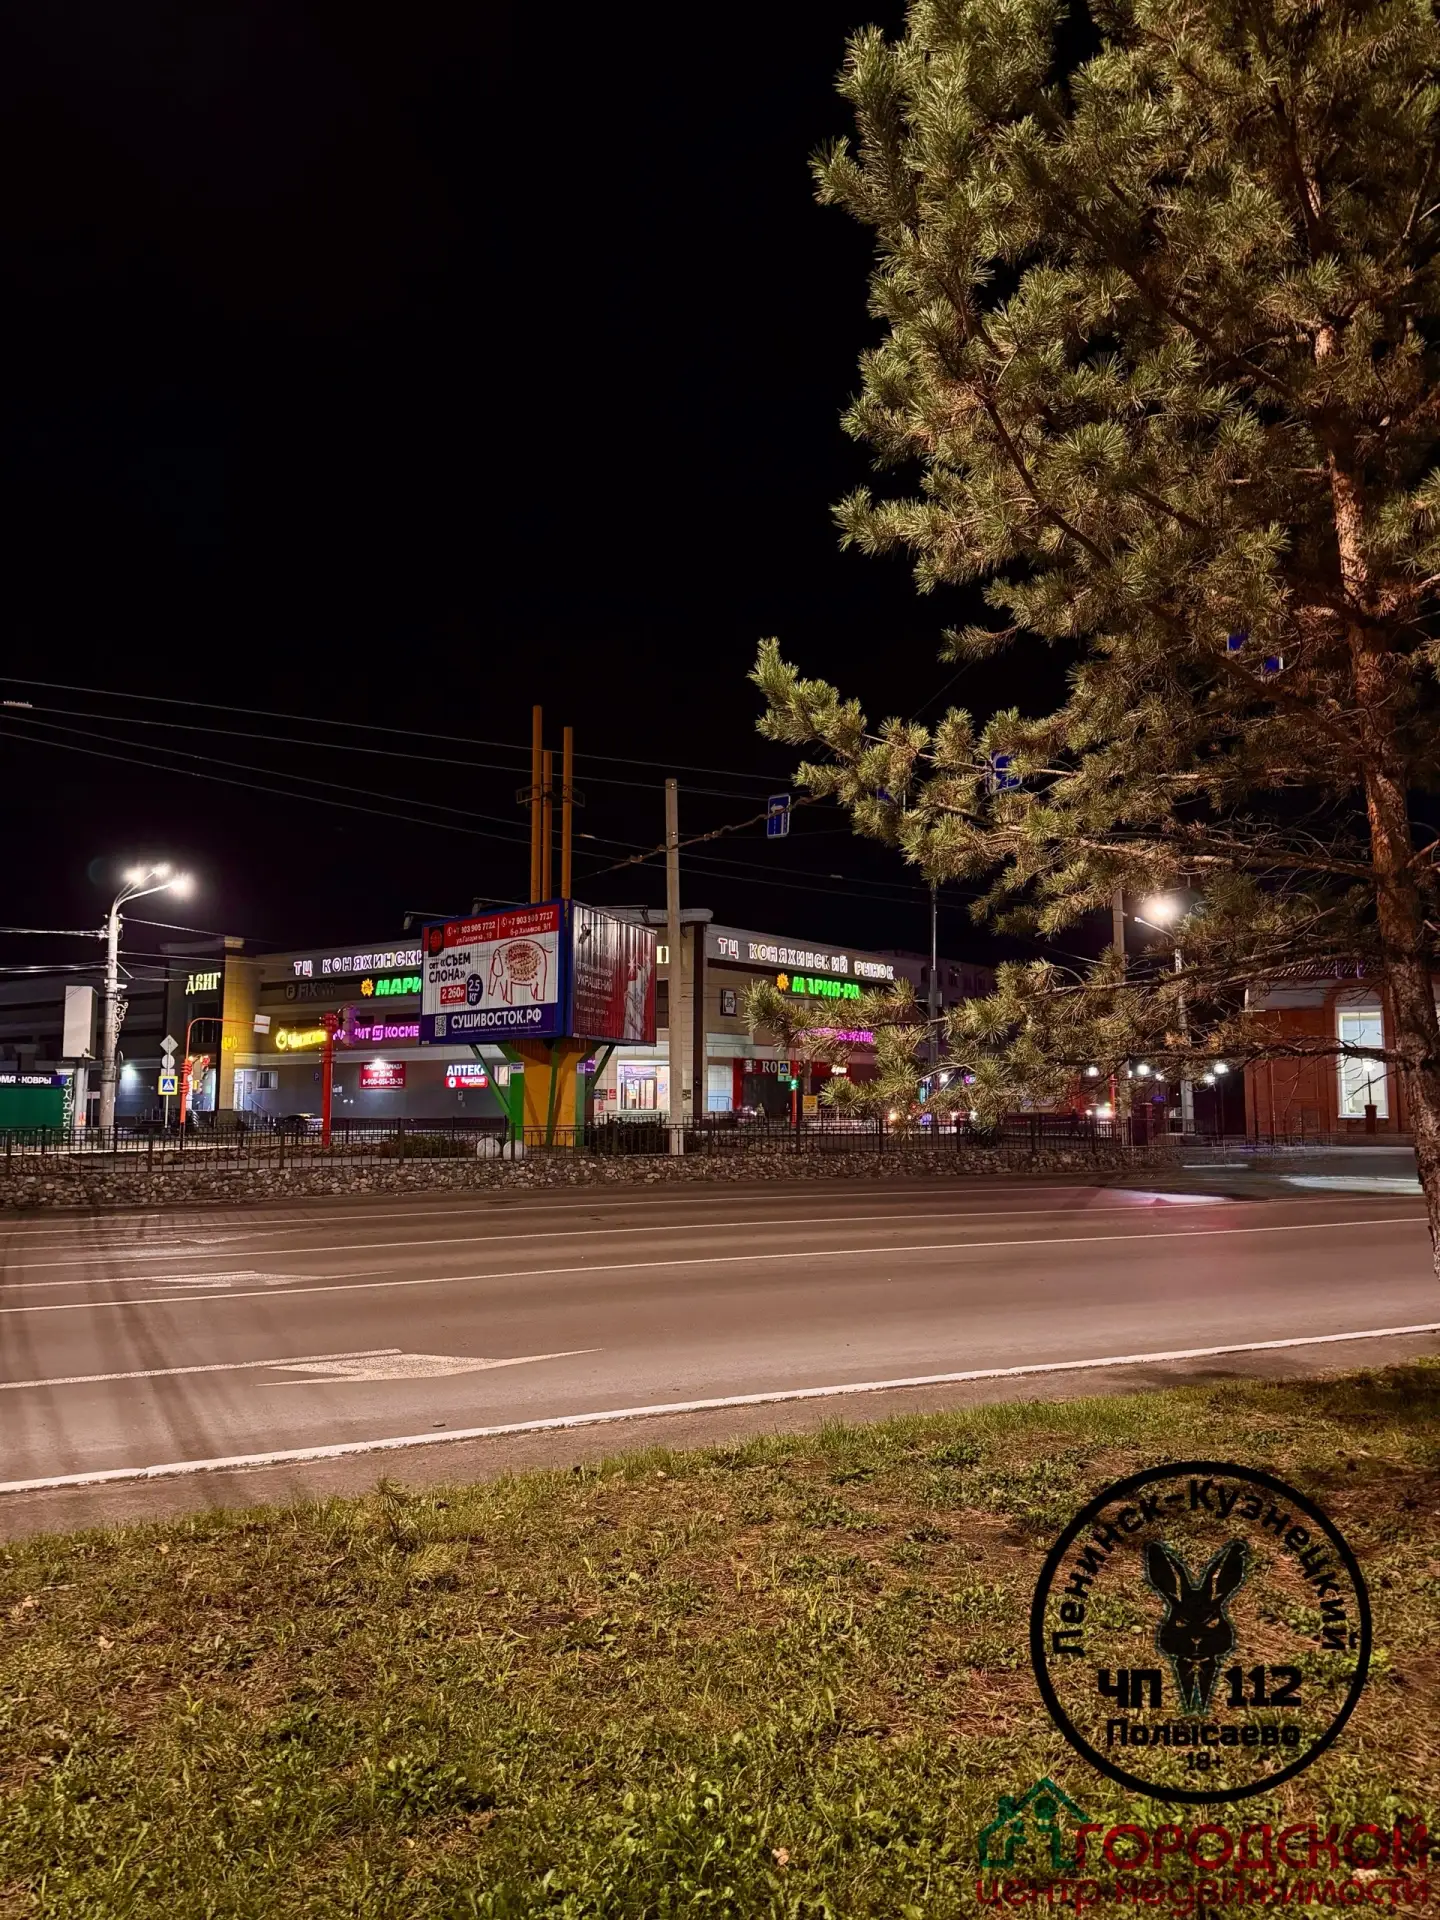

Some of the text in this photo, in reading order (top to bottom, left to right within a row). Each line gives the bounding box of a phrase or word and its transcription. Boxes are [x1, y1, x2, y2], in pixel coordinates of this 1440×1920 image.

[717, 938, 895, 980] ТЦ КОНЯХИНСКИЙ РЫНОК
[294, 960, 313, 978] ТЦ
[451, 1008, 542, 1029] СУШИВОСТОК.РФ
[21, 1076, 52, 1085] КОВРЫ
